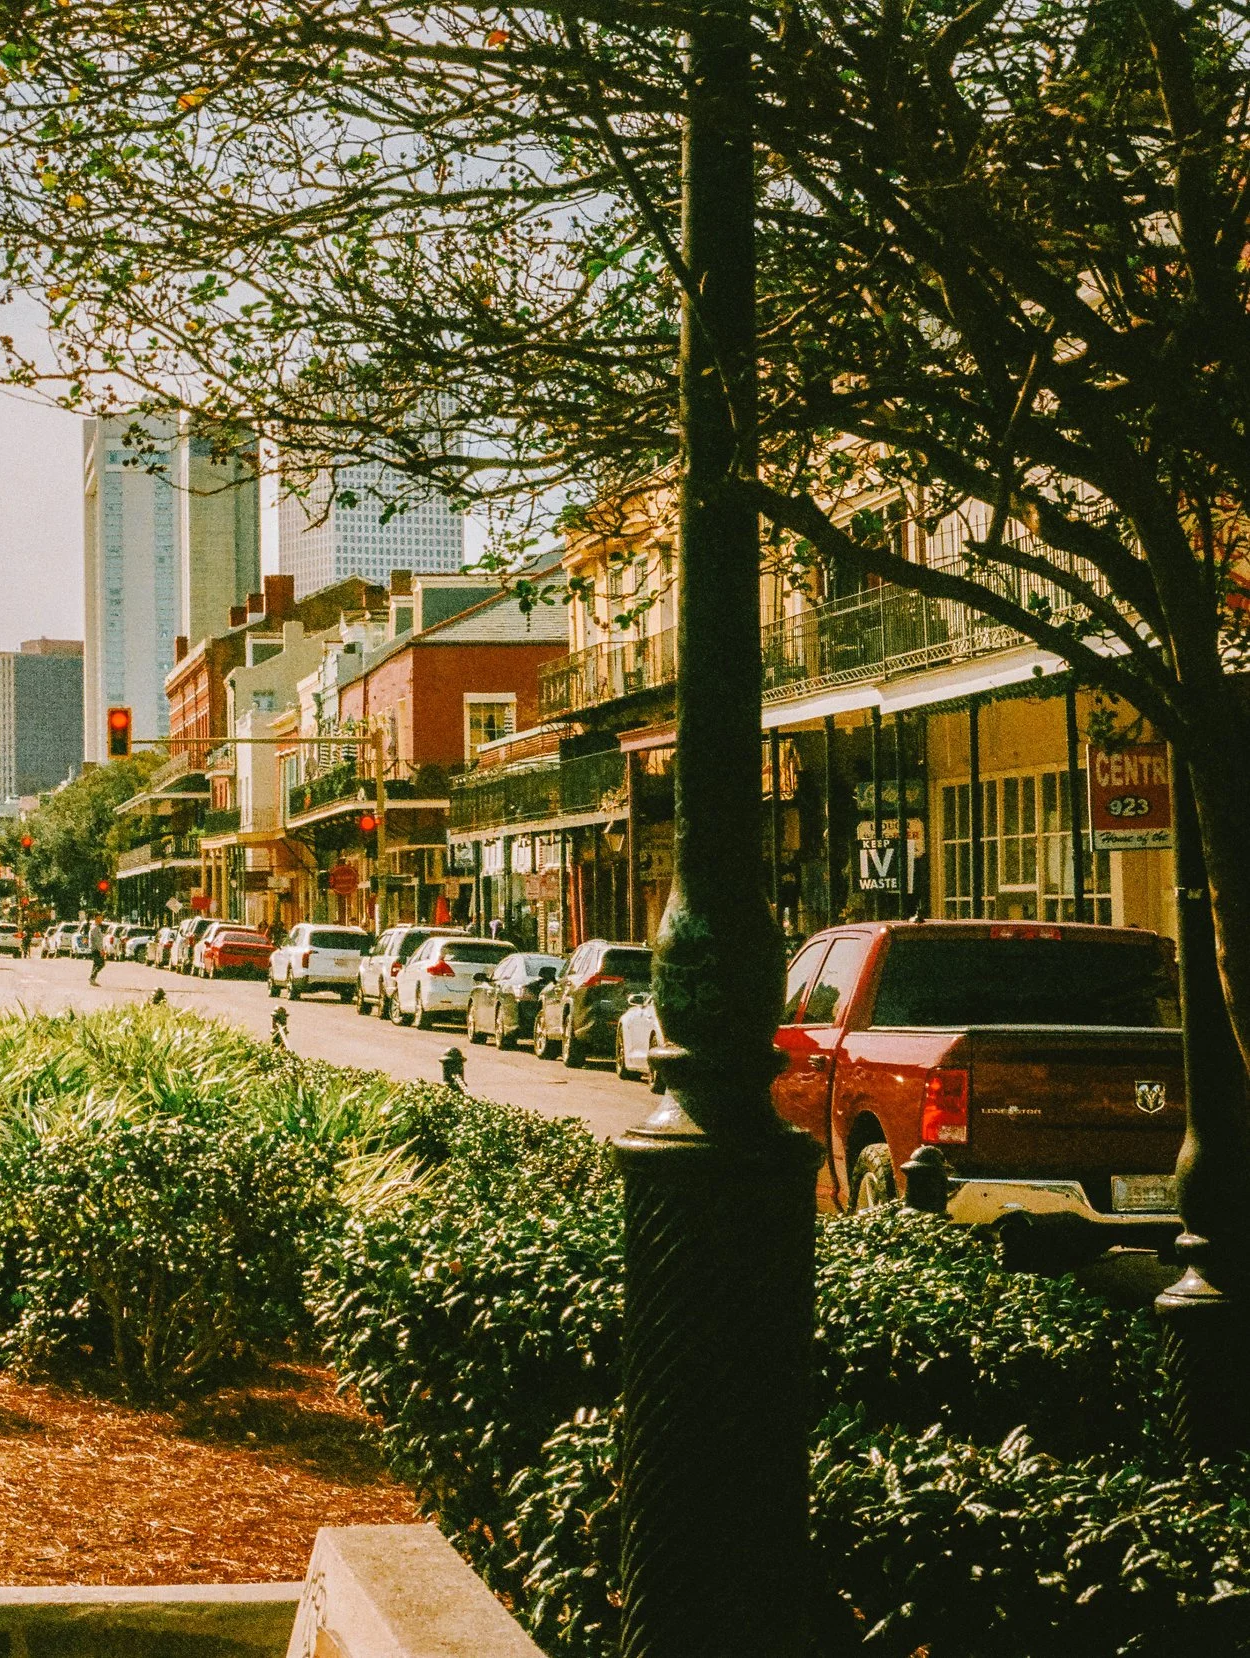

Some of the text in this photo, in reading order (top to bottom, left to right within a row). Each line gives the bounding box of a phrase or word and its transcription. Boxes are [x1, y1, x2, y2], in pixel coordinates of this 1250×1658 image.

[1110, 797, 1149, 817] 923
[862, 840, 891, 849] KEEP
[1099, 831, 1134, 843] Home
[1136, 831, 1150, 845] of
[859, 848, 895, 879] IV
[859, 878, 898, 890] WASTE
